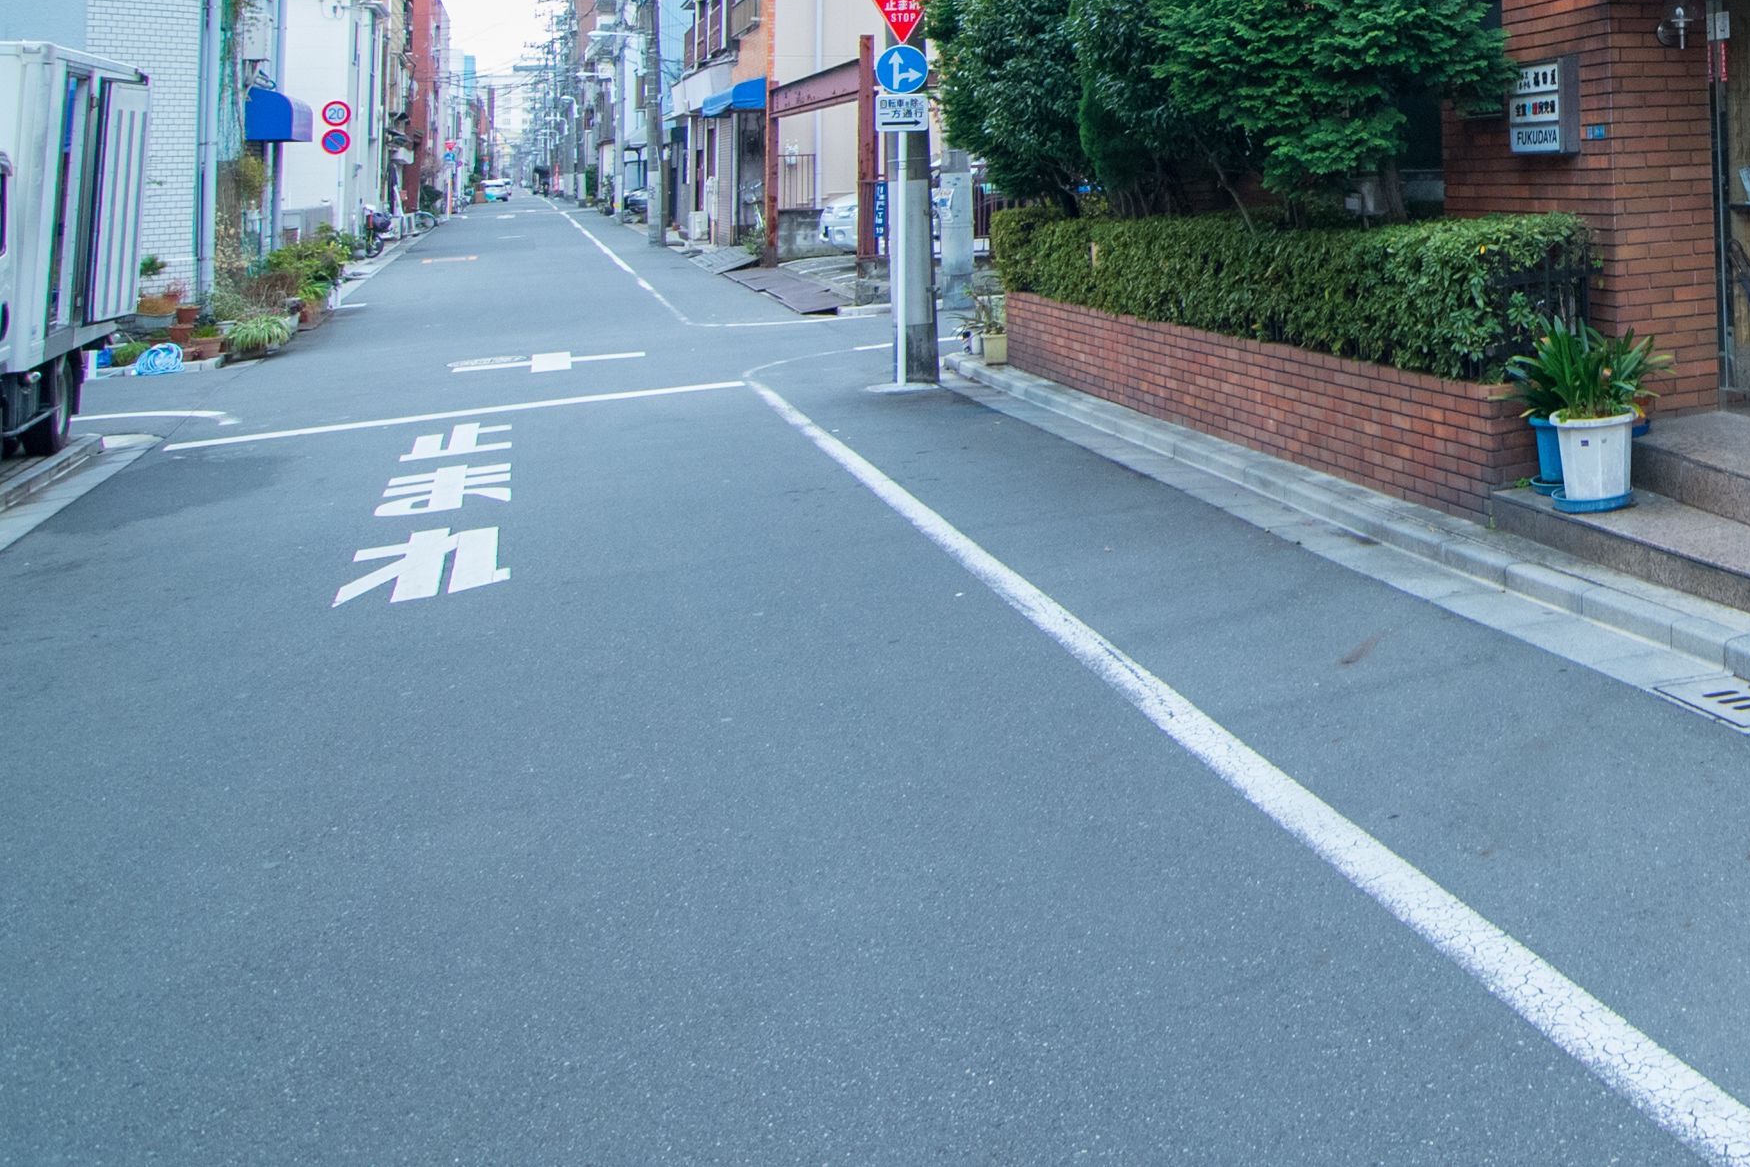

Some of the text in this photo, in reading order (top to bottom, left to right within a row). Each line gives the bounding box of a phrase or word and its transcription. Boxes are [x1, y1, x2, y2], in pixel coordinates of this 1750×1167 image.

[884, 0, 921, 11] 止まれ
[891, 13, 916, 23] STOP
[880, 98, 923, 109] 自転車を除く
[328, 107, 345, 120] 20
[880, 107, 923, 119] 一方通行
[1516, 129, 1558, 145] FUKUDAYA
[332, 422, 513, 608] 止まれ
